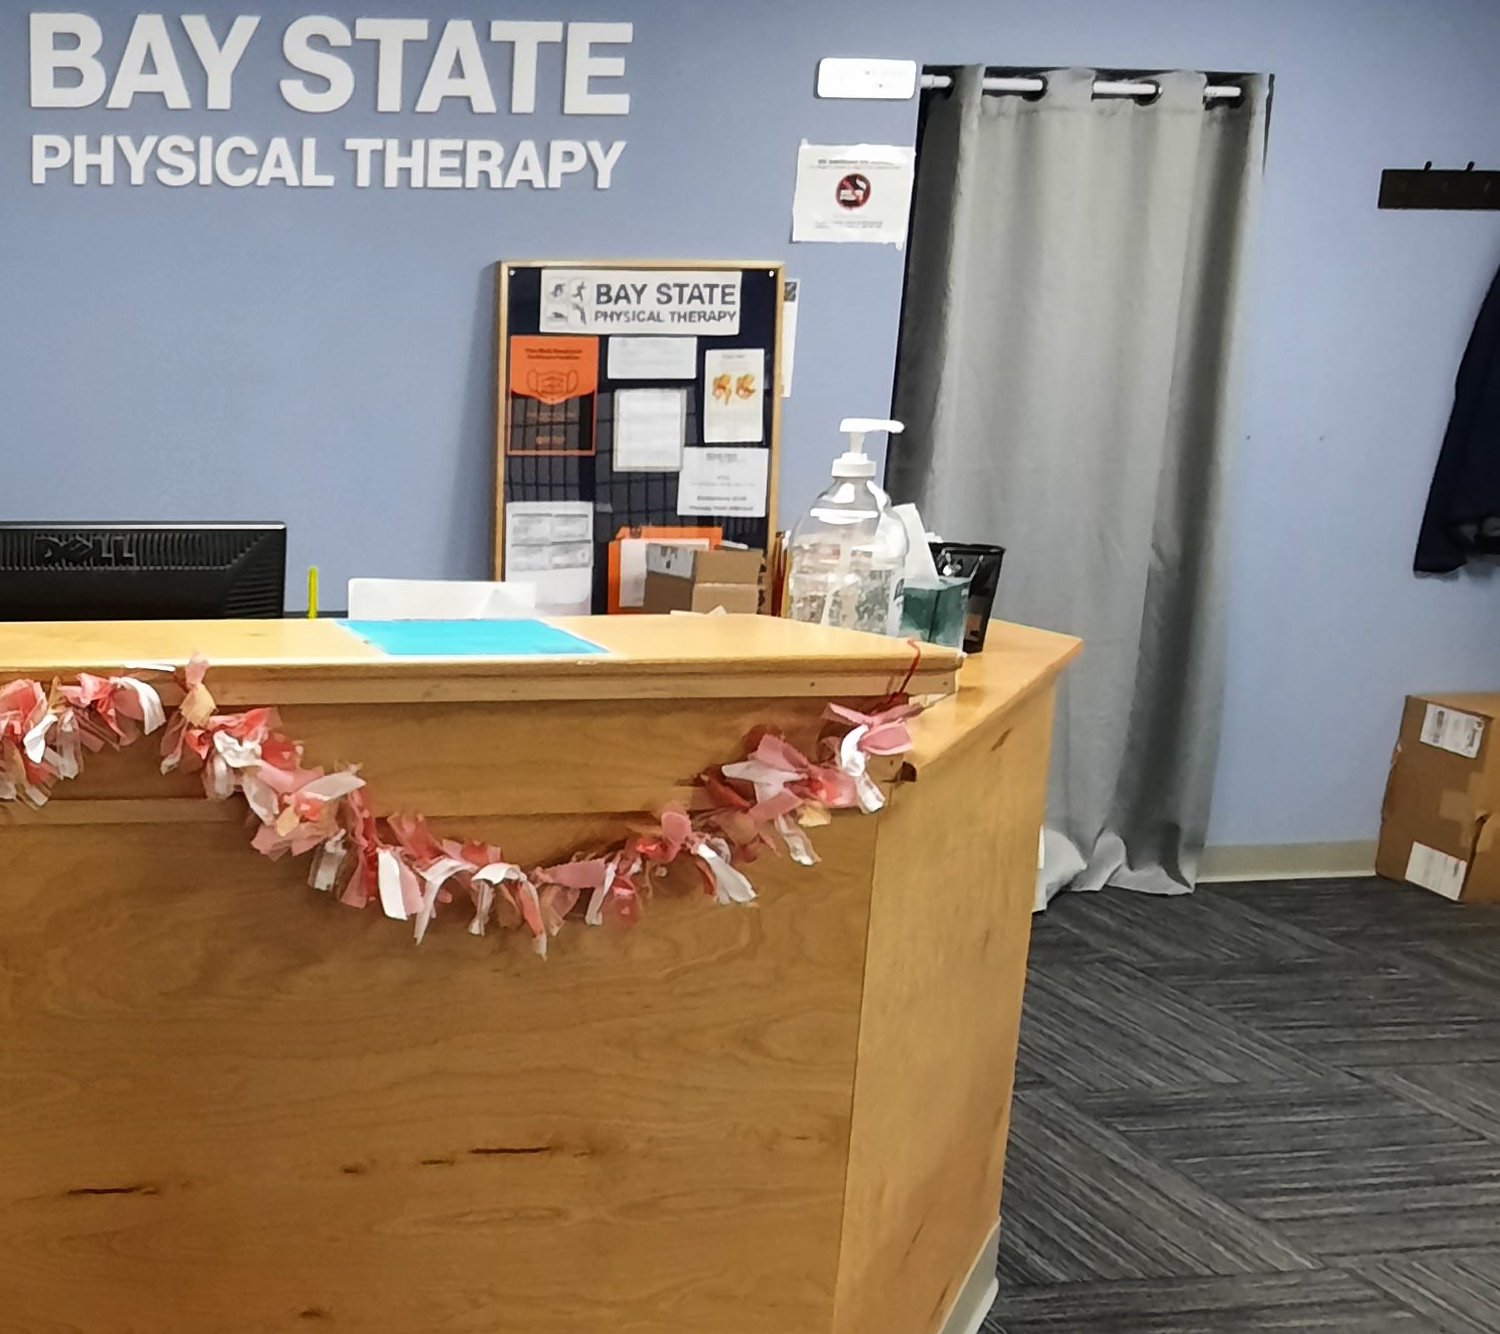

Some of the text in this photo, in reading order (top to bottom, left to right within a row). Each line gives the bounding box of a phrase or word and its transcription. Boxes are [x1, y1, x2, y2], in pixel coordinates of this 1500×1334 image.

[30, 11, 634, 116] BAY STATE
[30, 133, 627, 190] PHYSICAL THERAPY
[595, 283, 736, 306] BAY STATE
[594, 310, 737, 323] PHYSICAL THERAPY
[34, 533, 138, 568] DELL
